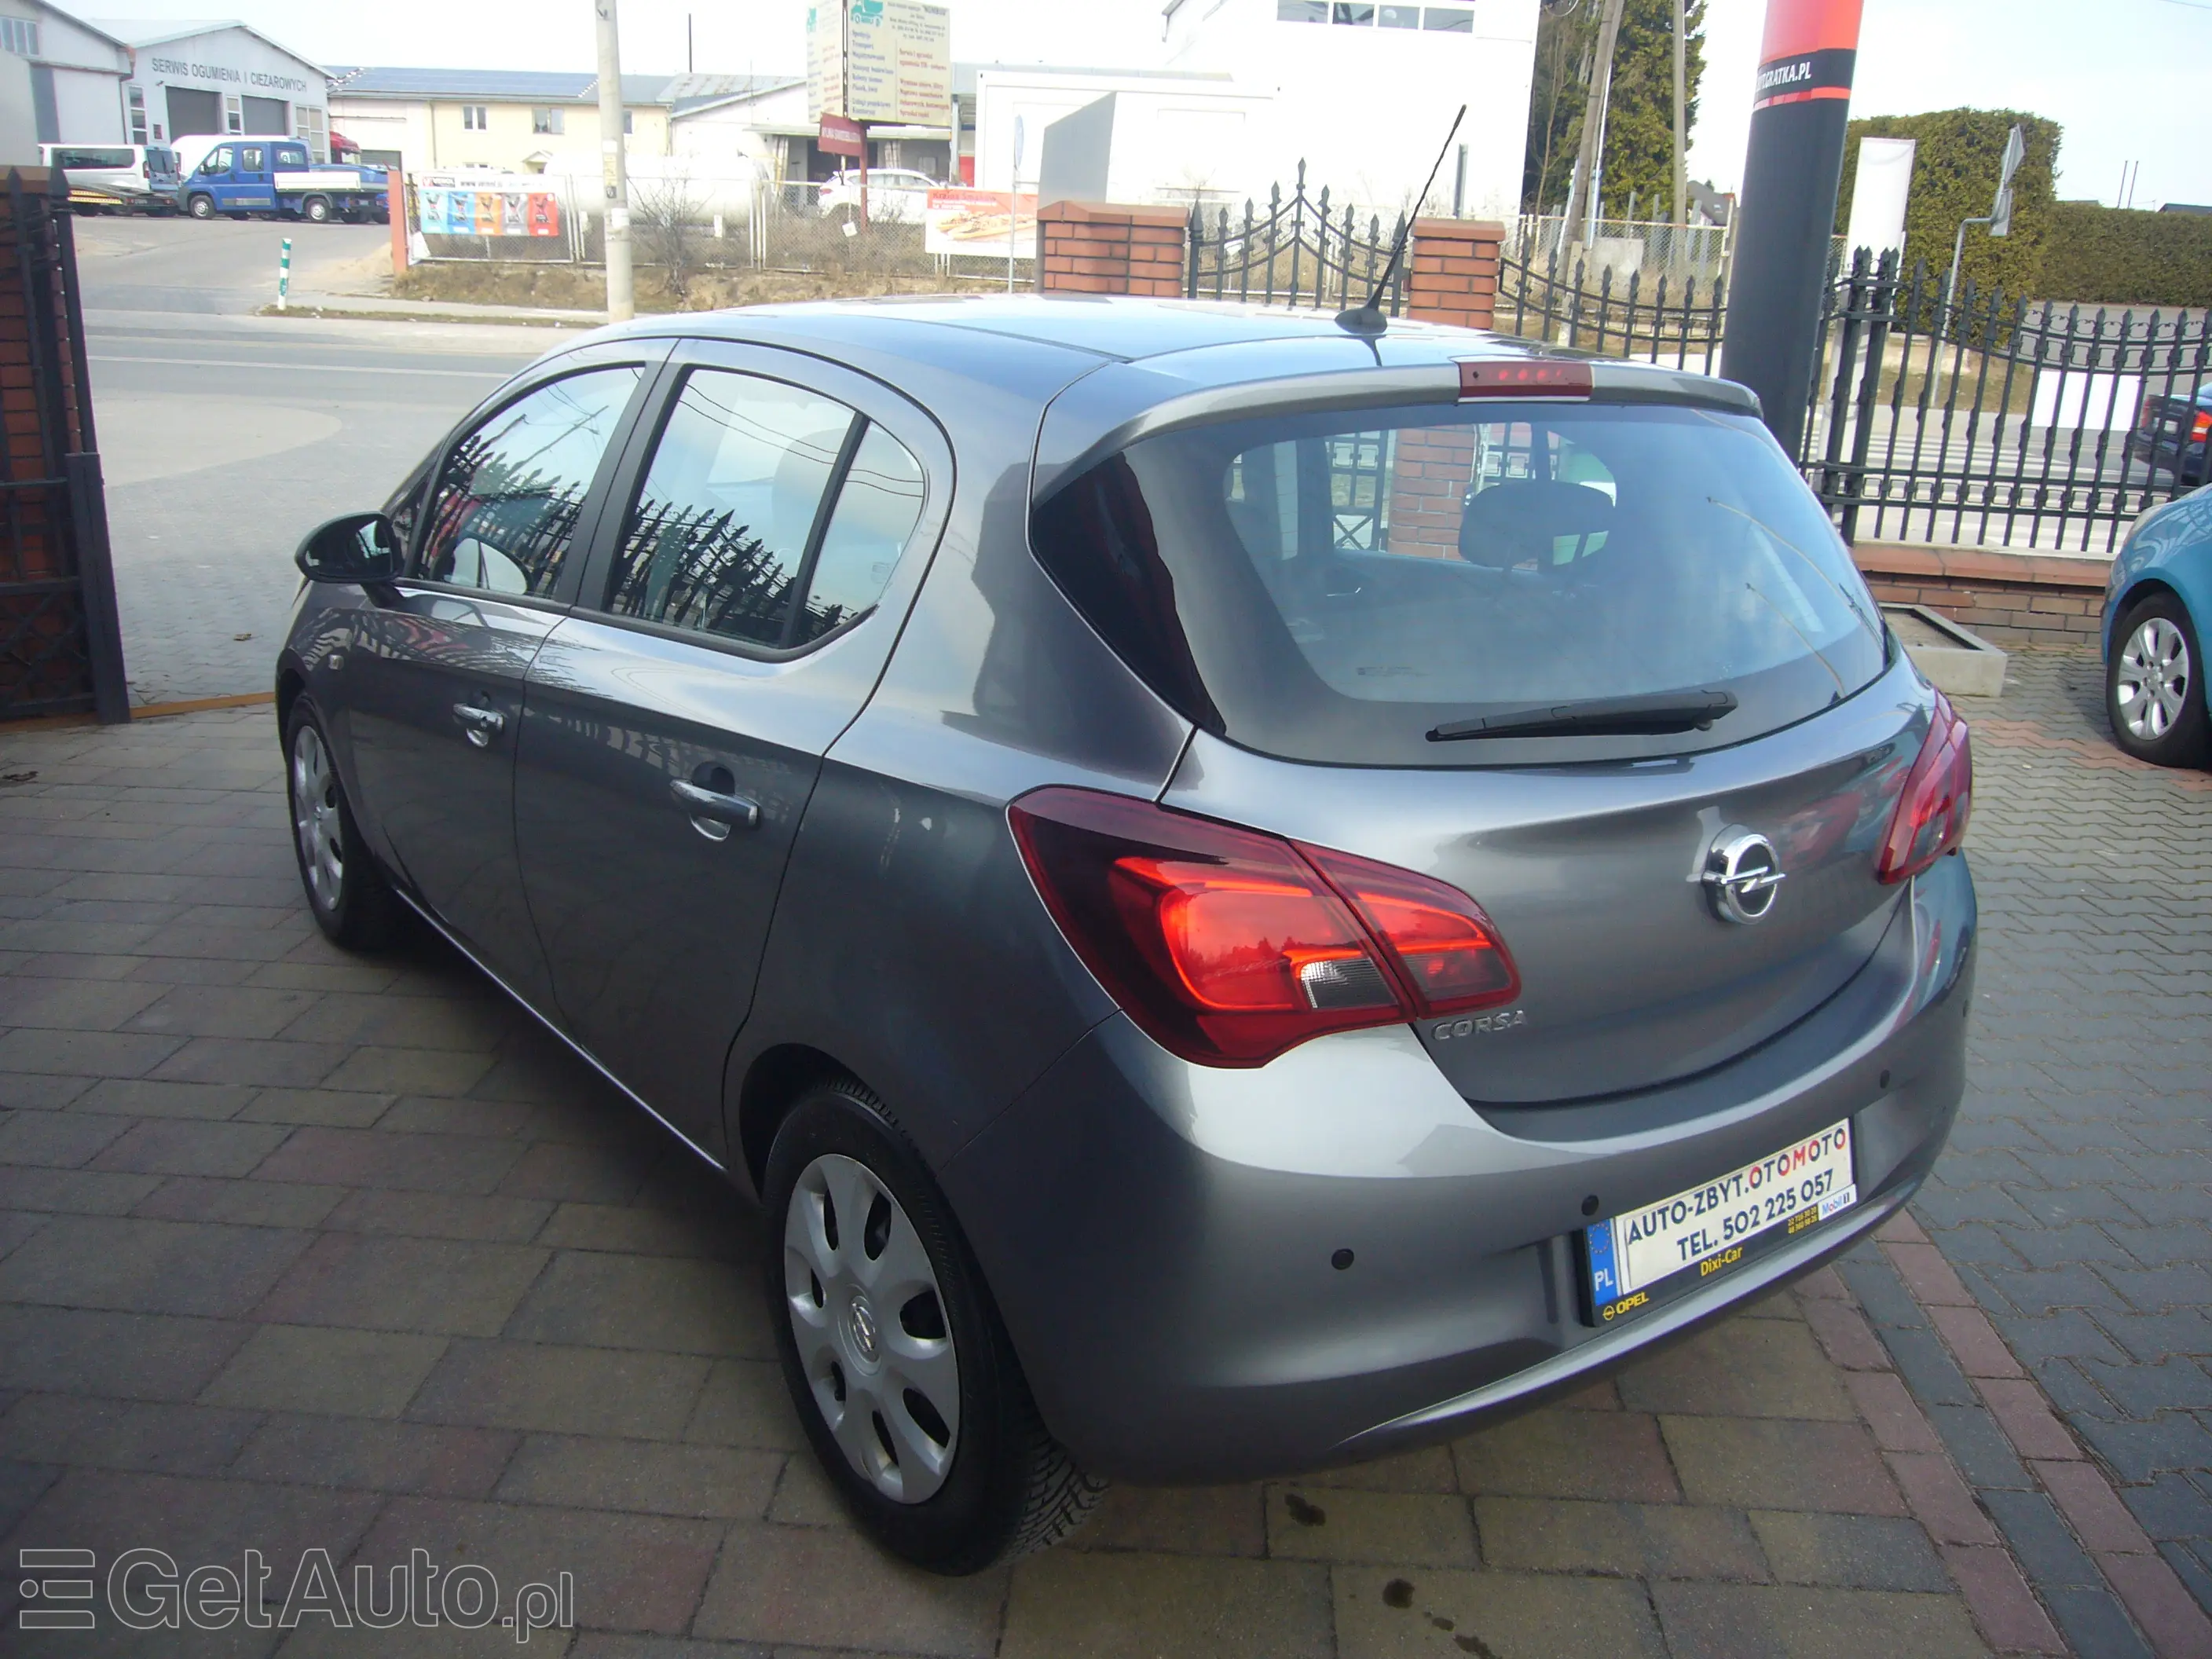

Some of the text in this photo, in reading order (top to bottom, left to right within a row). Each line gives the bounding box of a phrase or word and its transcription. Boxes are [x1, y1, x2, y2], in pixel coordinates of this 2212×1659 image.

[152, 57, 189, 75] SERWIS
[191, 64, 241, 83] OGUMIENIA
[244, 71, 248, 85] I
[1431, 1009, 1528, 1041] CORSA
[1628, 1127, 1847, 1245] AUTO-ZBYT.OTOMOTO
[1676, 1168, 1835, 1262] TEL. 502 225 057
[1822, 1196, 1842, 1216] Mobil
[1699, 1245, 1744, 1278] Dixi-Car
[1594, 1269, 1614, 1292] PL
[1616, 1291, 1650, 1316] OPEL
